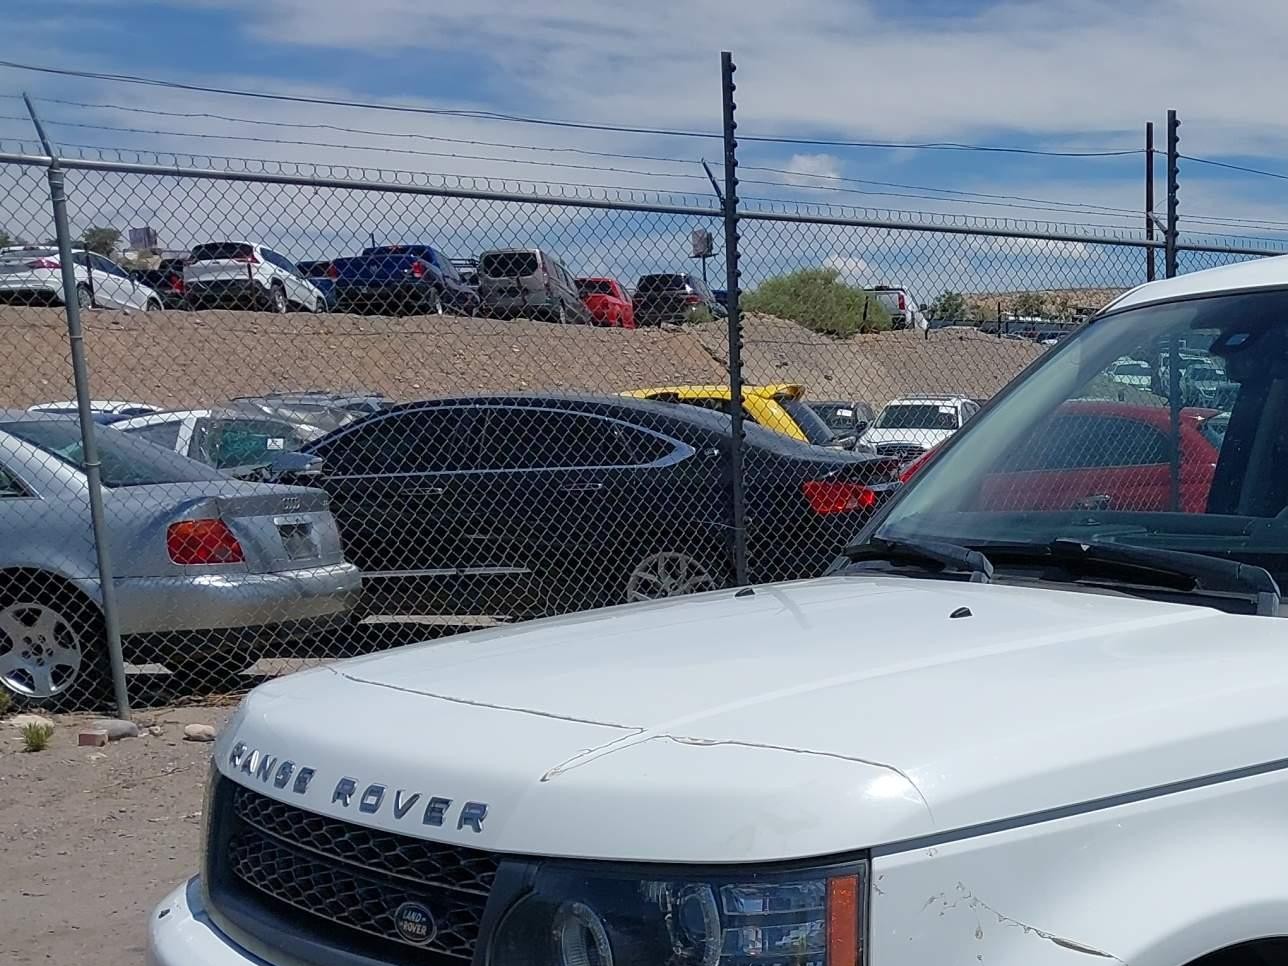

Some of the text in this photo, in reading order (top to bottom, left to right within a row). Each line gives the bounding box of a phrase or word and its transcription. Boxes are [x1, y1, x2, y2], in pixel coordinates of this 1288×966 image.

[228, 740, 490, 834] RANGE ROVER
[402, 910, 422, 922] LAND
[403, 921, 428, 936] ROVER
